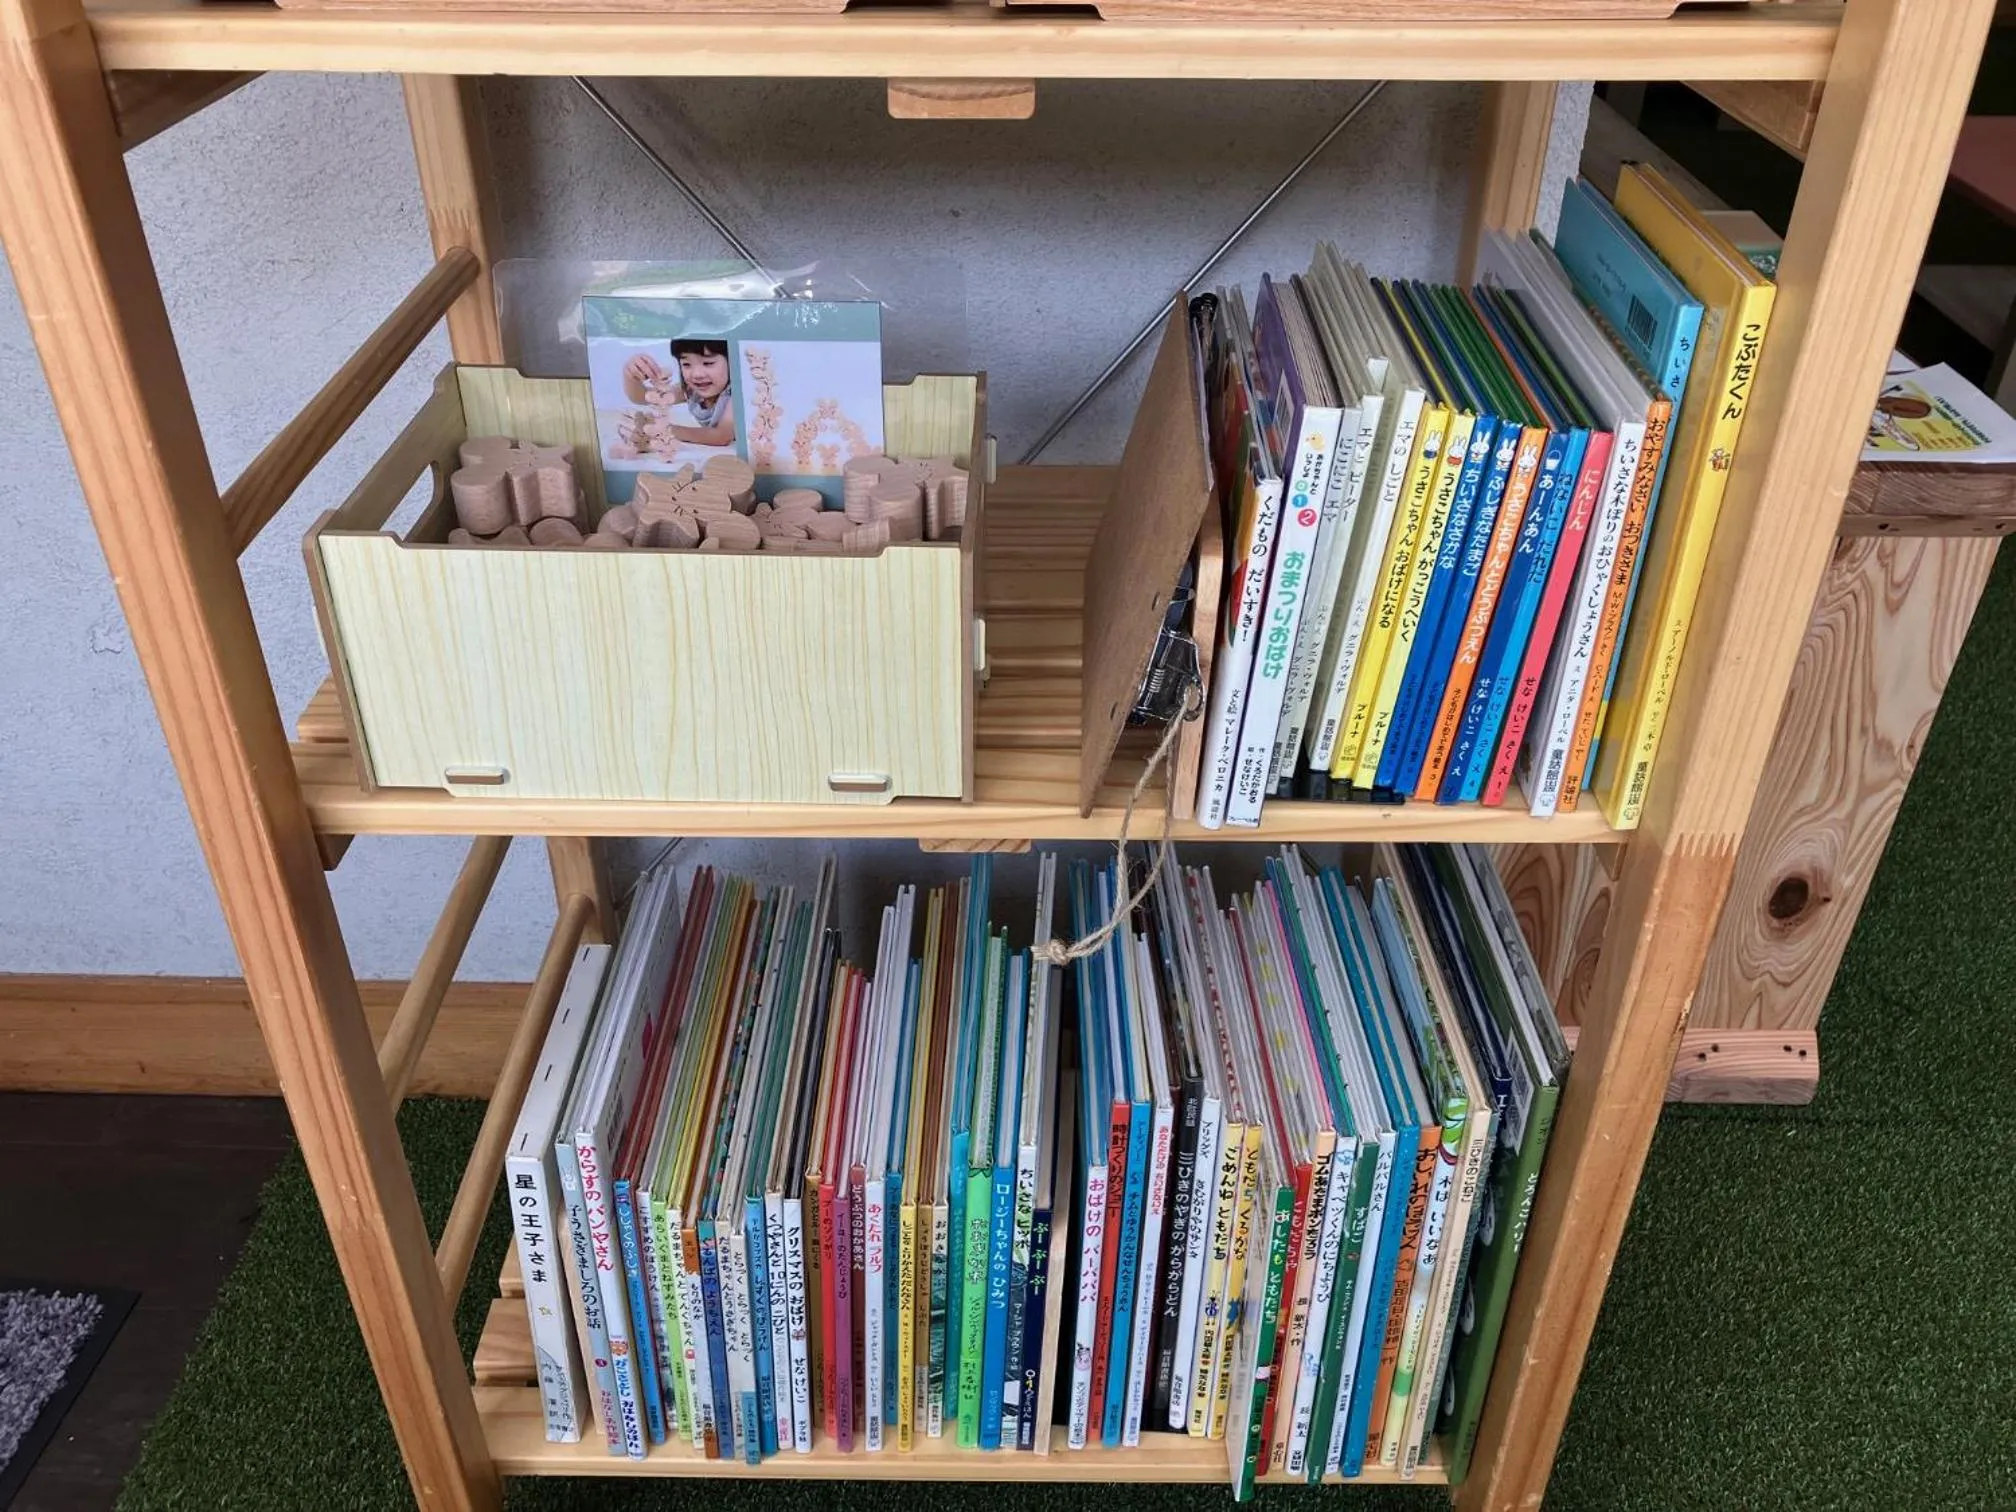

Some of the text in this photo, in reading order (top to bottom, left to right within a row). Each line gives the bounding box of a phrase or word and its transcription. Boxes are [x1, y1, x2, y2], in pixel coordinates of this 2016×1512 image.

[1721, 323, 1761, 420] こぶたくん
[1322, 437, 1353, 522] にこにこ エマ
[1342, 427, 1372, 522] エマと ピーター
[1382, 420, 1413, 502] エマの しごと
[1568, 469, 1600, 530] にんじん
[1616, 417, 1665, 588] おやすみなさい おつきさま
[1251, 495, 1273, 557] くだもの
[1378, 466, 1430, 630] うさこちゃん おばけになる
[1421, 472, 1454, 554] うさこちゃん
[1437, 466, 1480, 572] ちいさなさかな
[1460, 473, 1506, 581] ふしぎなたまご
[1518, 473, 1554, 553] あーんあん
[1261, 549, 1304, 680] おまつりおばけ
[1400, 557, 1434, 642] がっこうへいく
[515, 1173, 547, 1283] 星の王子さま
[579, 1144, 612, 1271] からすの パンやさん
[1016, 1168, 1033, 1214] ちいさな
[1234, 1148, 1258, 1260] ともだち くるかな
[1301, 1152, 1331, 1262] ゴムあたまポンたろう
[1350, 1205, 1367, 1243] すばこ
[1370, 1151, 1392, 1211] バルバルさん
[1422, 1175, 1451, 1264] 木は いいなあ
[787, 1226, 803, 1327] クリスマスの おばけ
[991, 1183, 1010, 1308] ロージーちゃんの ひみつ
[1080, 1178, 1104, 1302] おばけの バーバパパ
[1160, 1150, 1194, 1317] 三びきのやぎのがらがらどん
[1213, 1206, 1230, 1260] ともだち
[1267, 1208, 1290, 1266] あしたも
[1316, 1170, 1349, 1306] キャベツくんのにちようび
[1260, 1270, 1283, 1324] ともだち
[794, 1357, 806, 1403] せな けいこ
